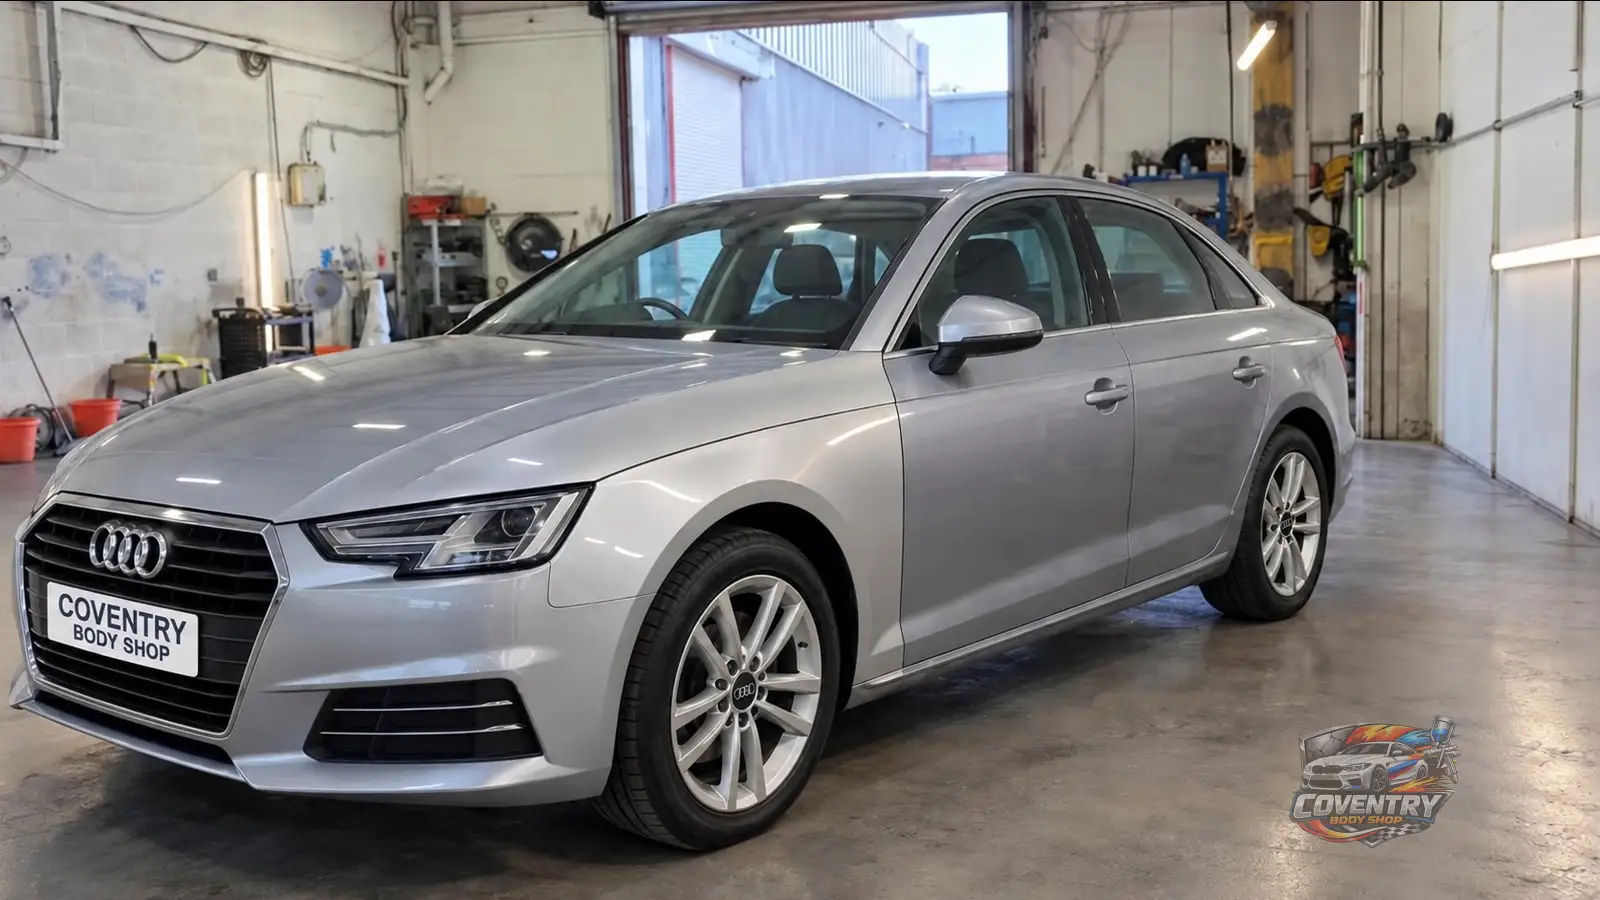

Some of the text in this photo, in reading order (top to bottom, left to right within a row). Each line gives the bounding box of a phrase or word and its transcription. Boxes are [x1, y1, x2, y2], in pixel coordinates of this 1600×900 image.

[58, 593, 187, 645] COVENTRY
[73, 623, 170, 662] BODY SHOP
